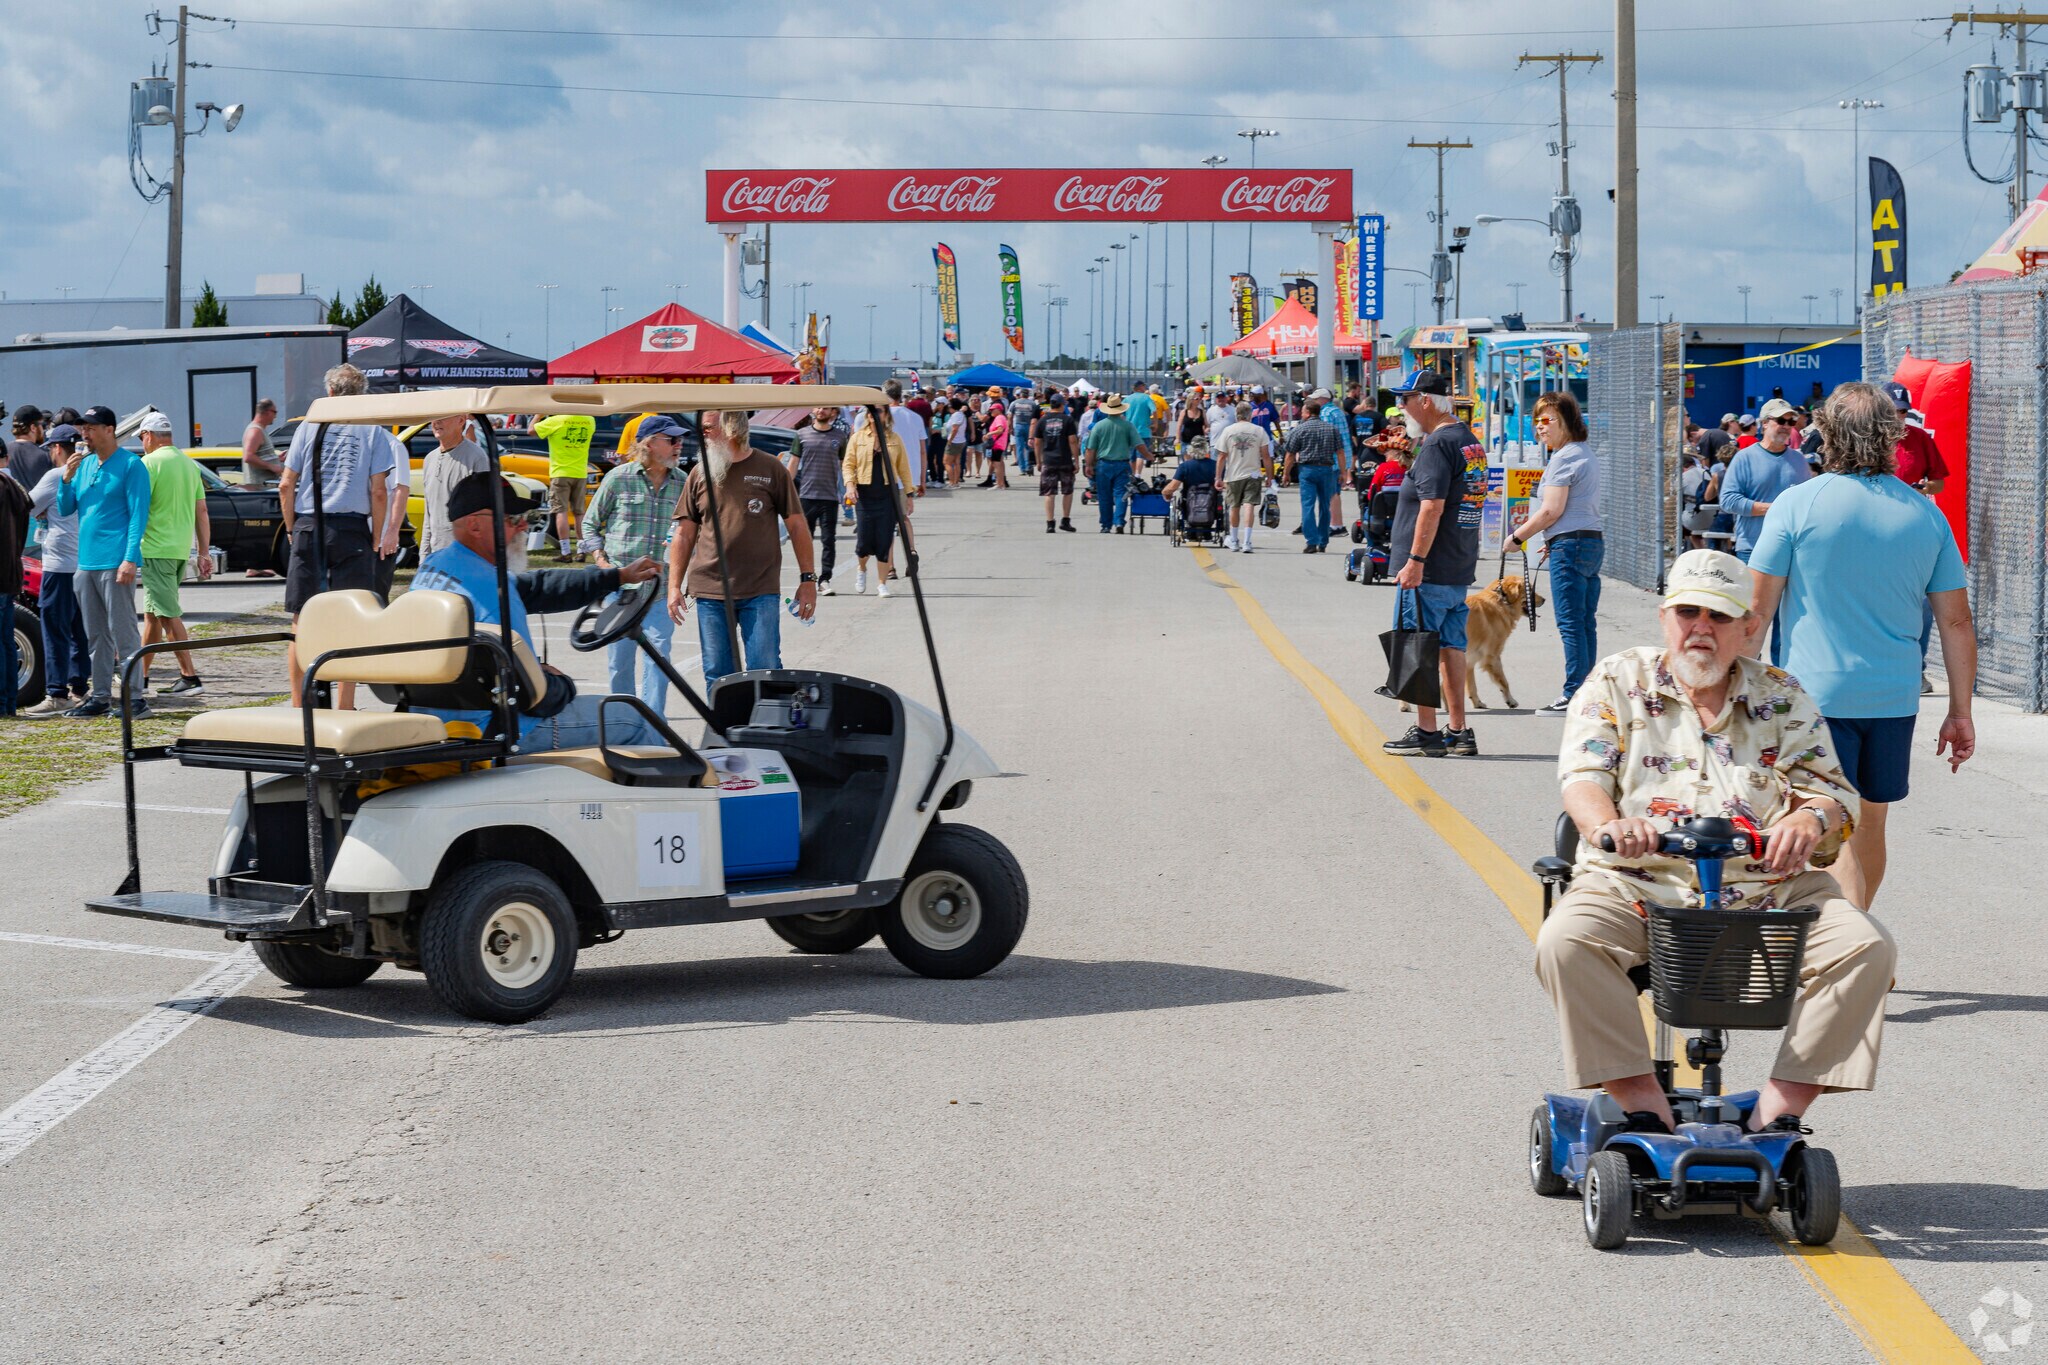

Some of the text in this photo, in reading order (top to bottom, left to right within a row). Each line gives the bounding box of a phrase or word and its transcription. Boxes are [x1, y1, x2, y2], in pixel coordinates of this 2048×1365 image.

[722, 177, 837, 213] Coca-Cola
[888, 176, 1003, 212] Coca-Cola
[1054, 176, 1170, 212] Coca-Cola
[1221, 176, 1337, 213] Coca-Cola
[1872, 199, 1904, 304] ATM
[1365, 236, 1377, 315] RESTROOMS
[421, 367, 528, 378] WWW.HANKSTERS.COM
[1780, 354, 1820, 369] MEN
[580, 812, 603, 820] 7528
[654, 835, 685, 864] 18
